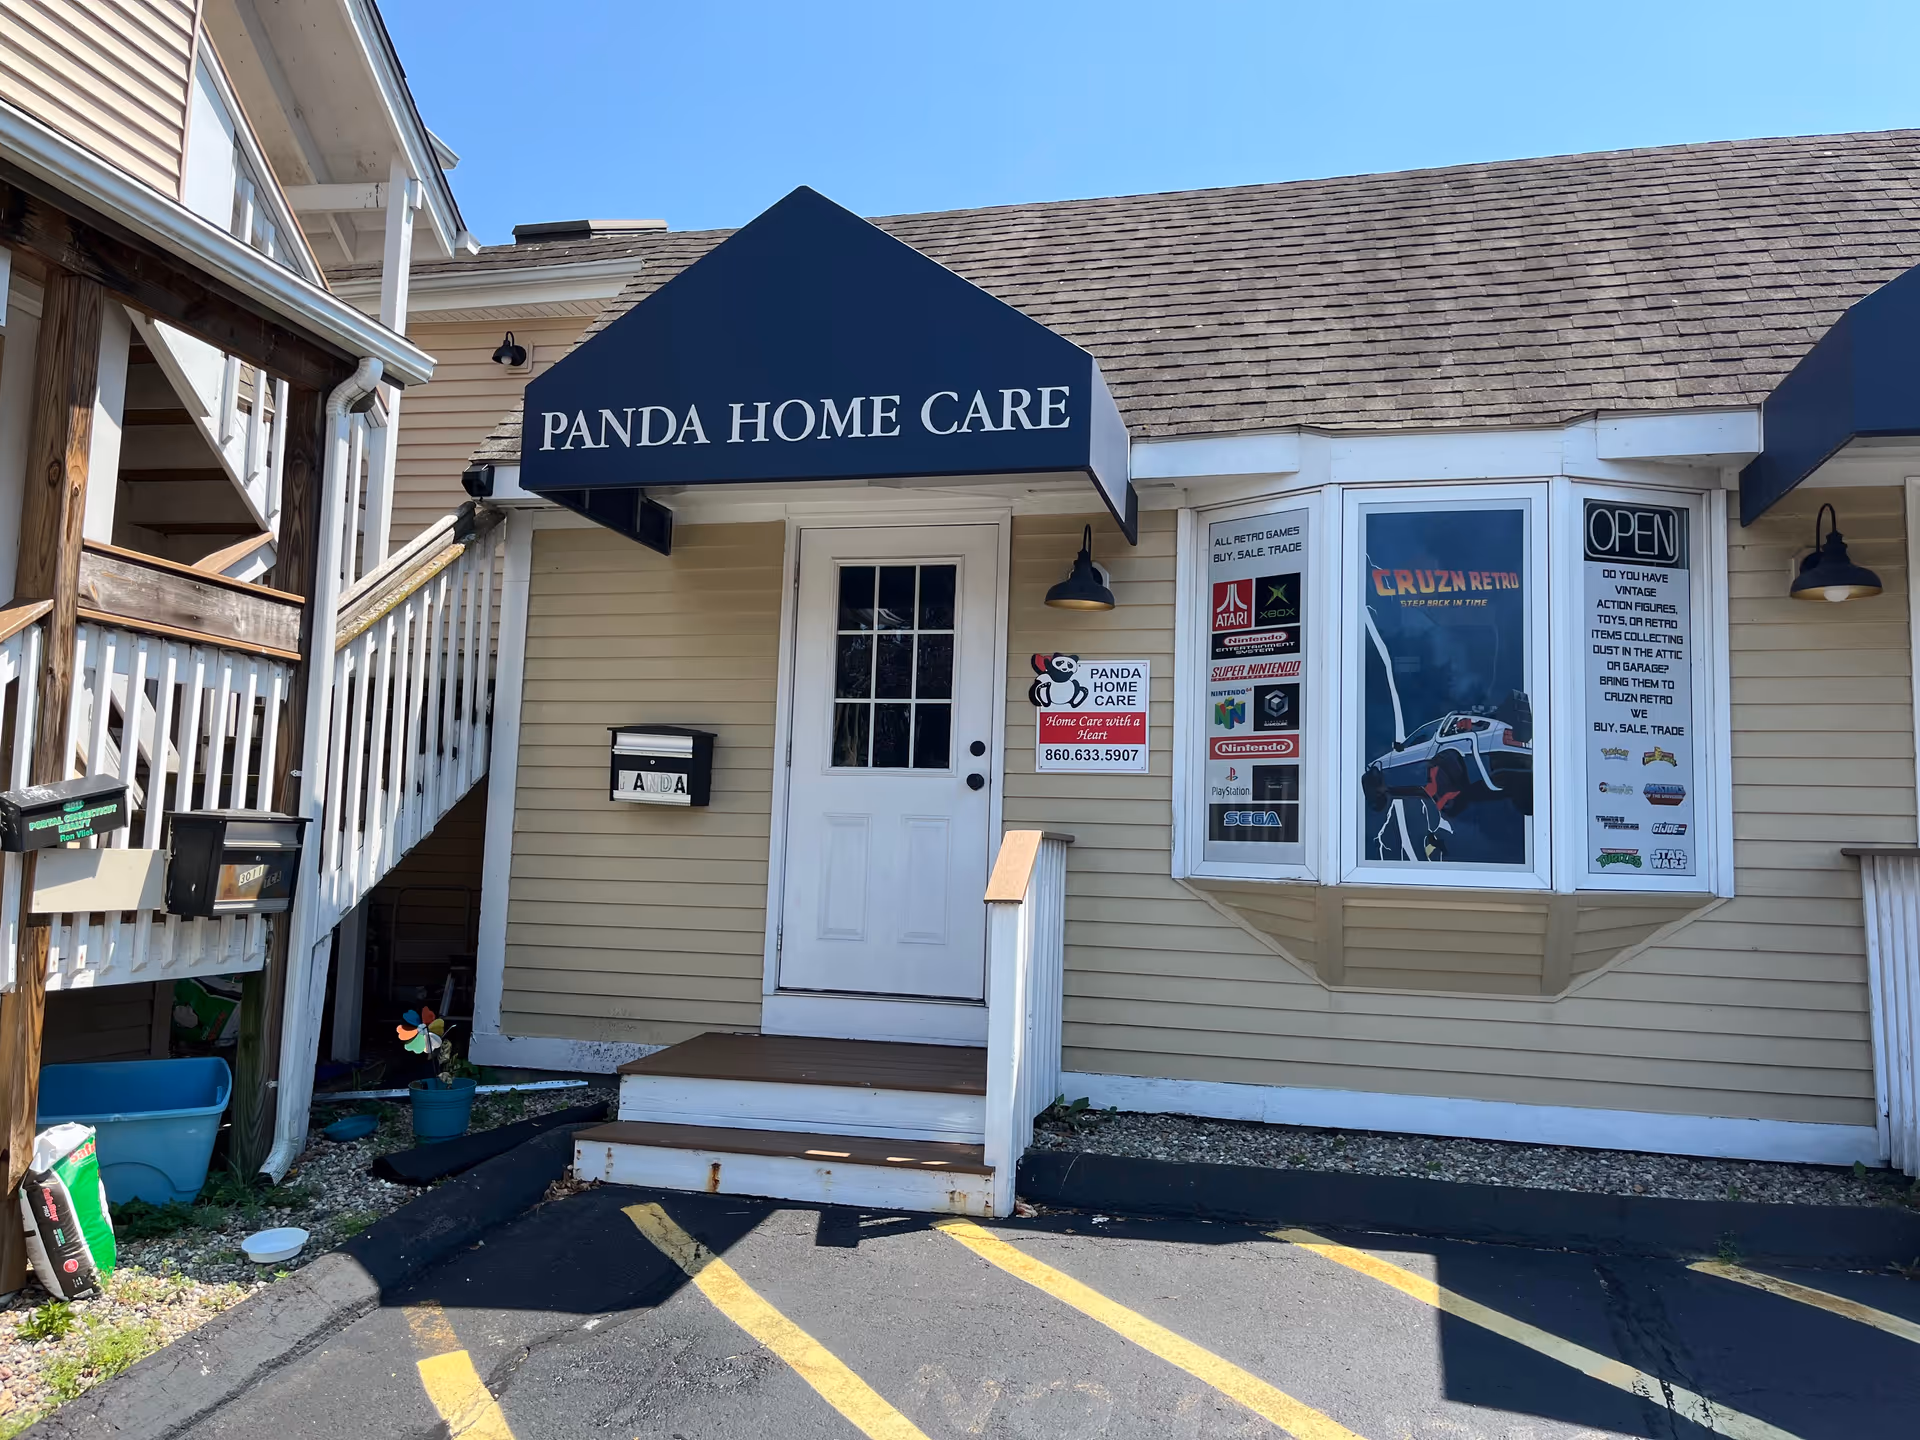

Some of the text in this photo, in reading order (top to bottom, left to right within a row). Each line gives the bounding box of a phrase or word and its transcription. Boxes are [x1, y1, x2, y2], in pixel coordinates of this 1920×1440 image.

[539, 386, 1071, 451] PANDA HOME CARE
[1214, 526, 1299, 547] ALL RETRO GAMES
[1590, 509, 1673, 556] OPEN
[1214, 552, 1235, 562] BUY,
[1268, 542, 1301, 555] TRADE
[1372, 569, 1519, 596] CRUZN RETRO
[1603, 569, 1668, 583] DO YOU HAVE
[1615, 585, 1656, 597] VINTAGE
[1259, 608, 1295, 619] XBOX
[1597, 599, 1677, 615] ACTION FIGURES,
[1215, 611, 1247, 627] ATARI
[1597, 615, 1677, 629] TOYS, OR RETRO
[1229, 635, 1281, 644] Nintendo
[1592, 629, 1683, 644] ITEMS COLLECTING
[1593, 645, 1682, 659] DUST IN THE ATTIC
[1090, 668, 1142, 678] PANDA
[1212, 665, 1245, 677] SUPER
[1247, 661, 1301, 674] NINTENDO
[1607, 661, 1669, 673] OR GARAGE?
[1094, 682, 1138, 692] HOME
[1600, 676, 1674, 689] BRING THEM TO
[1094, 695, 1136, 706] CARE
[1605, 692, 1672, 704] CRUZN RETRO
[1631, 709, 1648, 718] WE
[1046, 716, 1076, 726] Home
[1079, 716, 1102, 726] Care
[1106, 715, 1131, 726] with
[1076, 729, 1108, 740] Heart
[1594, 722, 1684, 736] BUY, SALE, TRADE
[1221, 742, 1285, 753] Nintendo
[1046, 749, 1139, 761] 860.633.5907
[1212, 786, 1250, 799] PlayStation
[1224, 811, 1282, 827] SEGA
[60, 834, 75, 842] Ron
[1650, 849, 1687, 859] STAR
[1650, 859, 1687, 869] WARS
[241, 867, 261, 883] 3011
